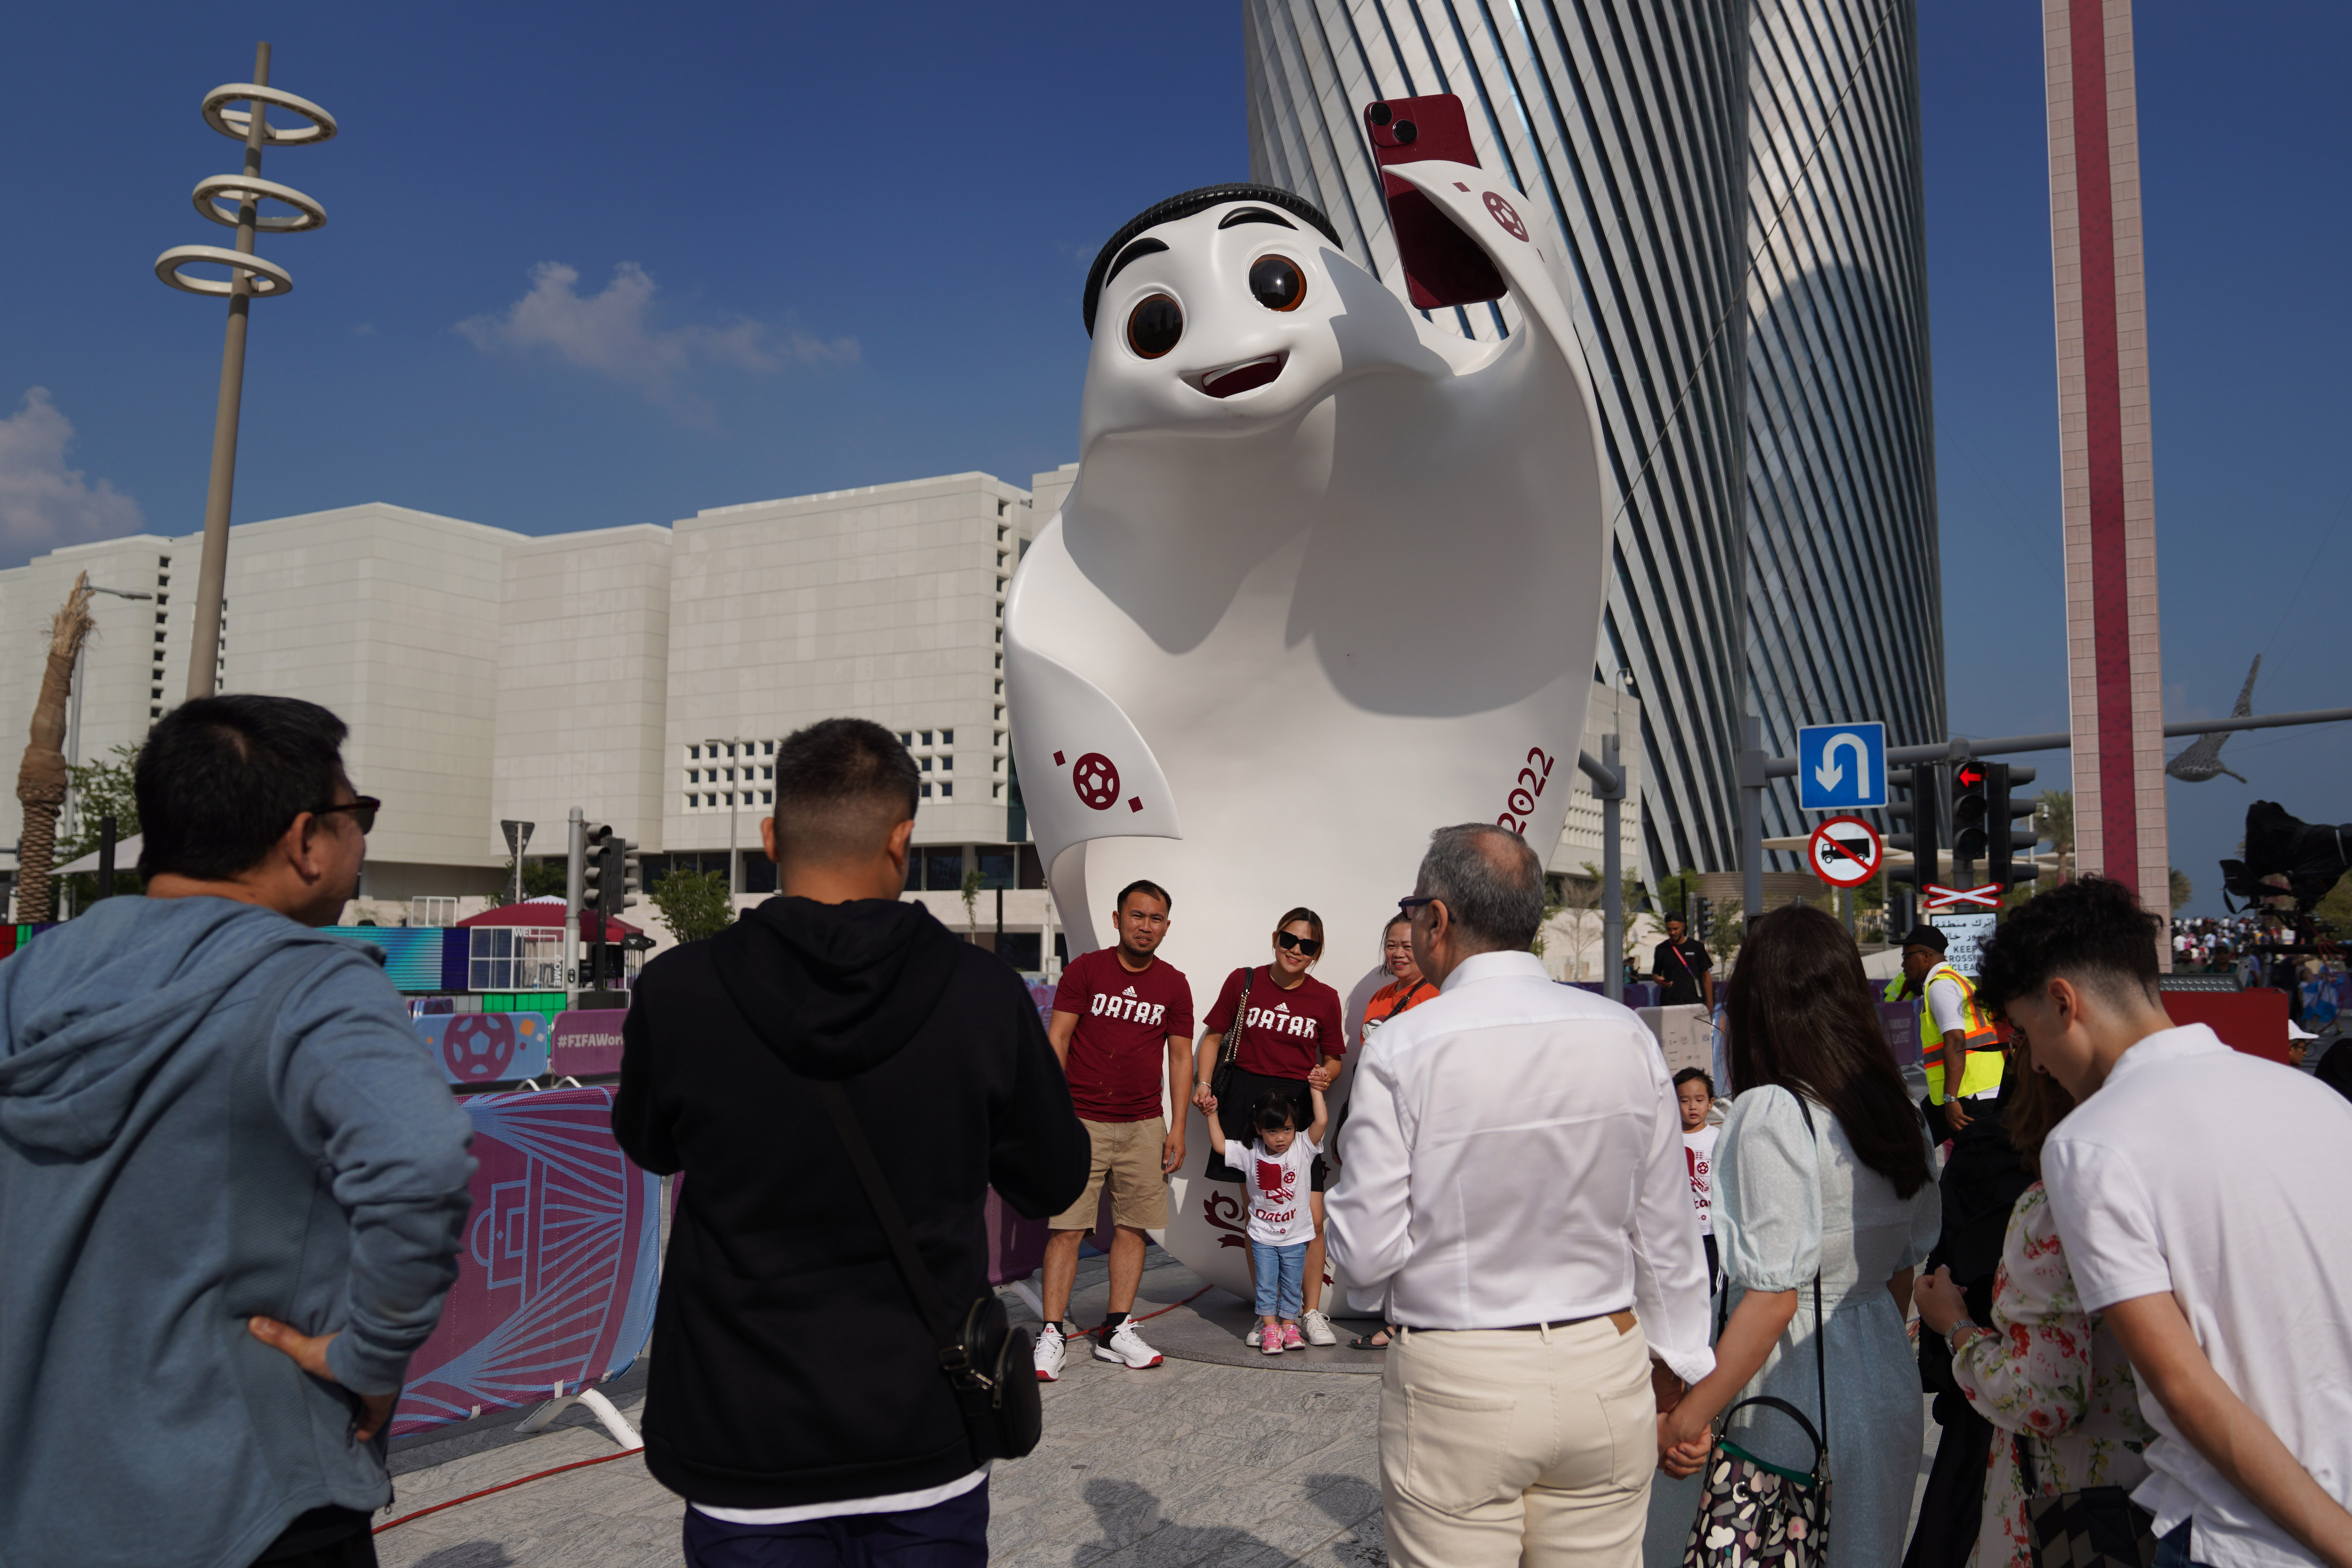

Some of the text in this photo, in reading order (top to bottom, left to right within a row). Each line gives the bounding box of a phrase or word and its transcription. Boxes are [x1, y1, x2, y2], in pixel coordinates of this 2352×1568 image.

[1497, 747, 1554, 835] 2022
[1971, 917, 1993, 928] اترك
[1090, 993, 1165, 1026] QATAR
[1246, 1007, 1317, 1039] QATAR
[557, 1032, 624, 1048] #FIFAWorl
[1694, 1198, 1711, 1209] tar
[1255, 1208, 1296, 1222] Qatar
